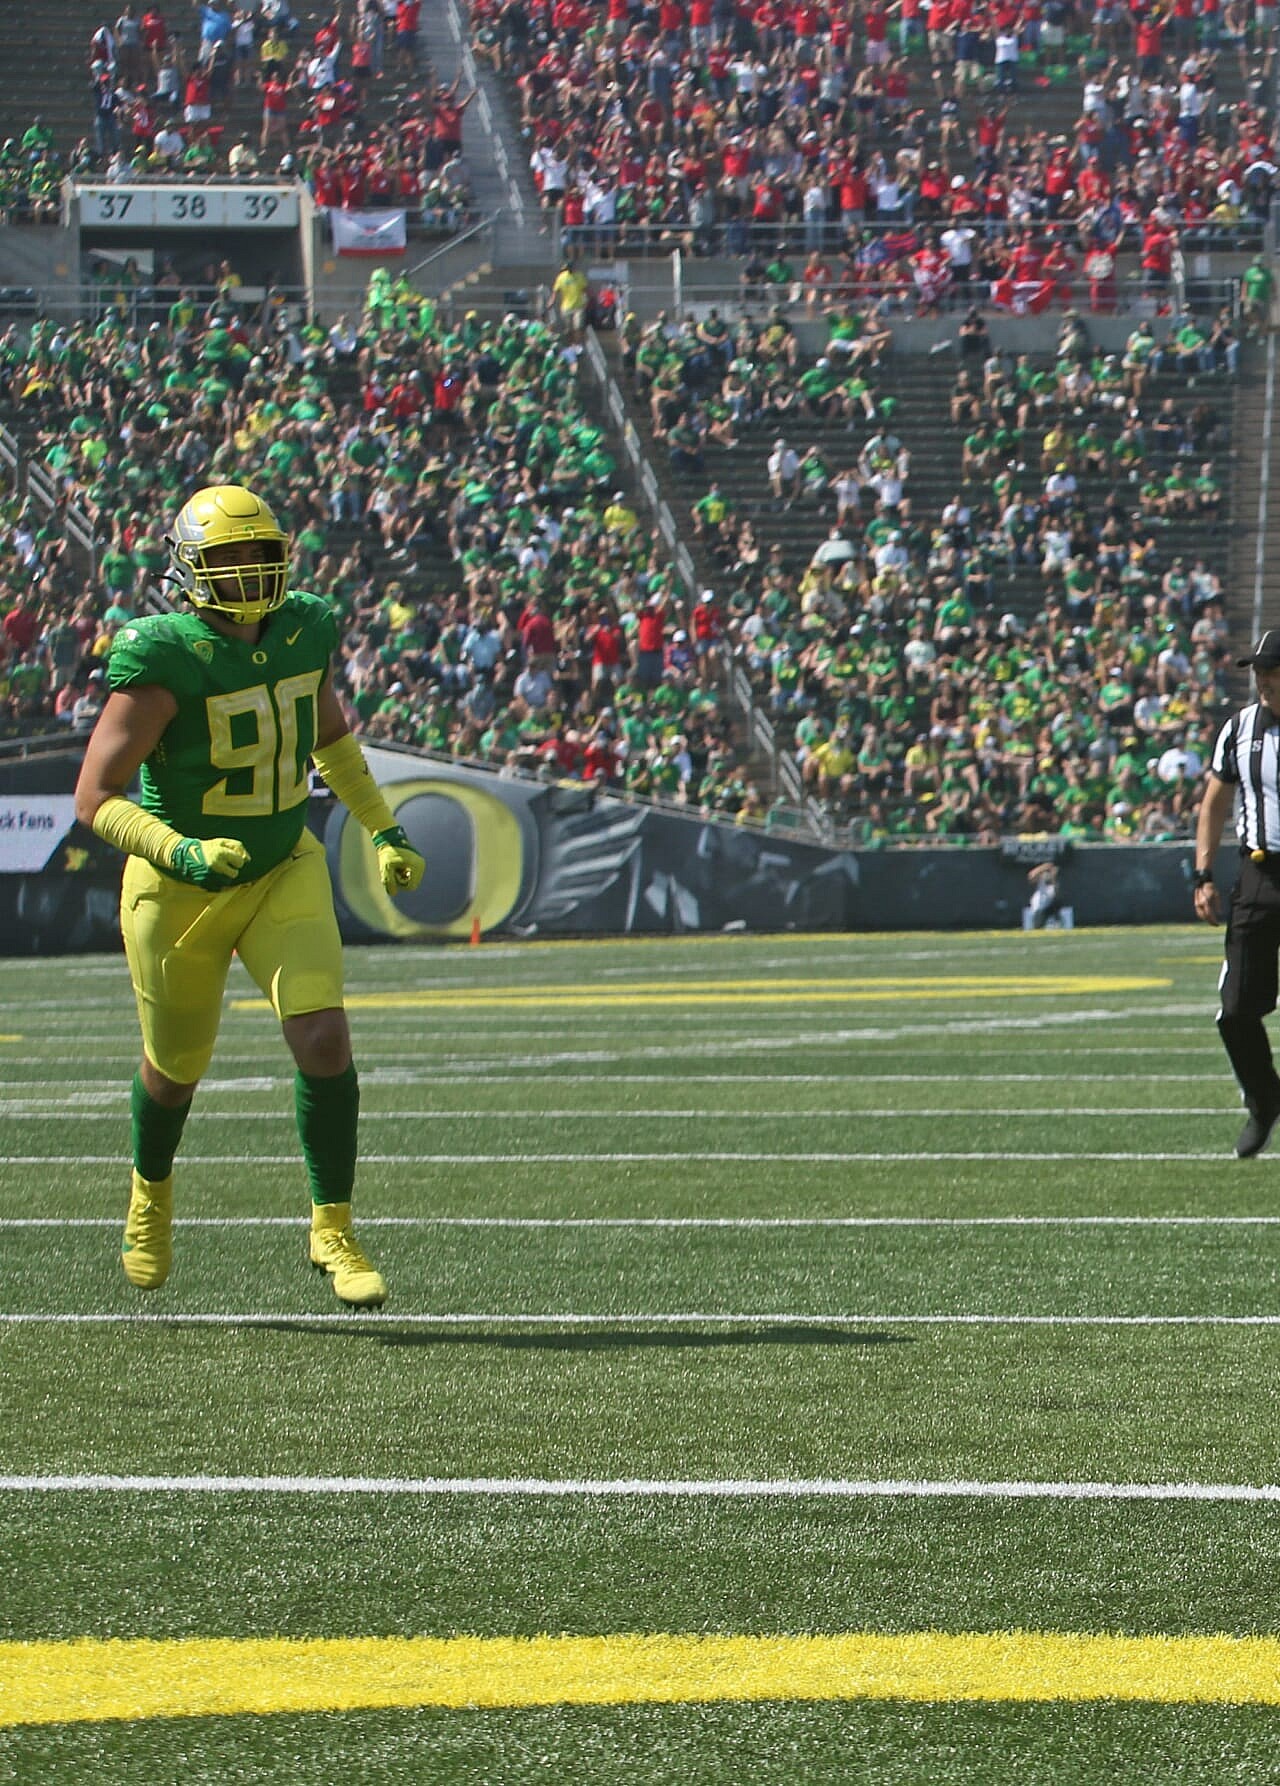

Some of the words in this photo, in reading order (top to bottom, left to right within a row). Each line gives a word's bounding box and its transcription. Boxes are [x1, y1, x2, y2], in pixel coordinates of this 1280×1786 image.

[99, 194, 134, 220] 37
[172, 194, 207, 220] 38
[245, 195, 280, 220] 39
[202, 668, 324, 817] 90
[19, 810, 54, 829] Fans
